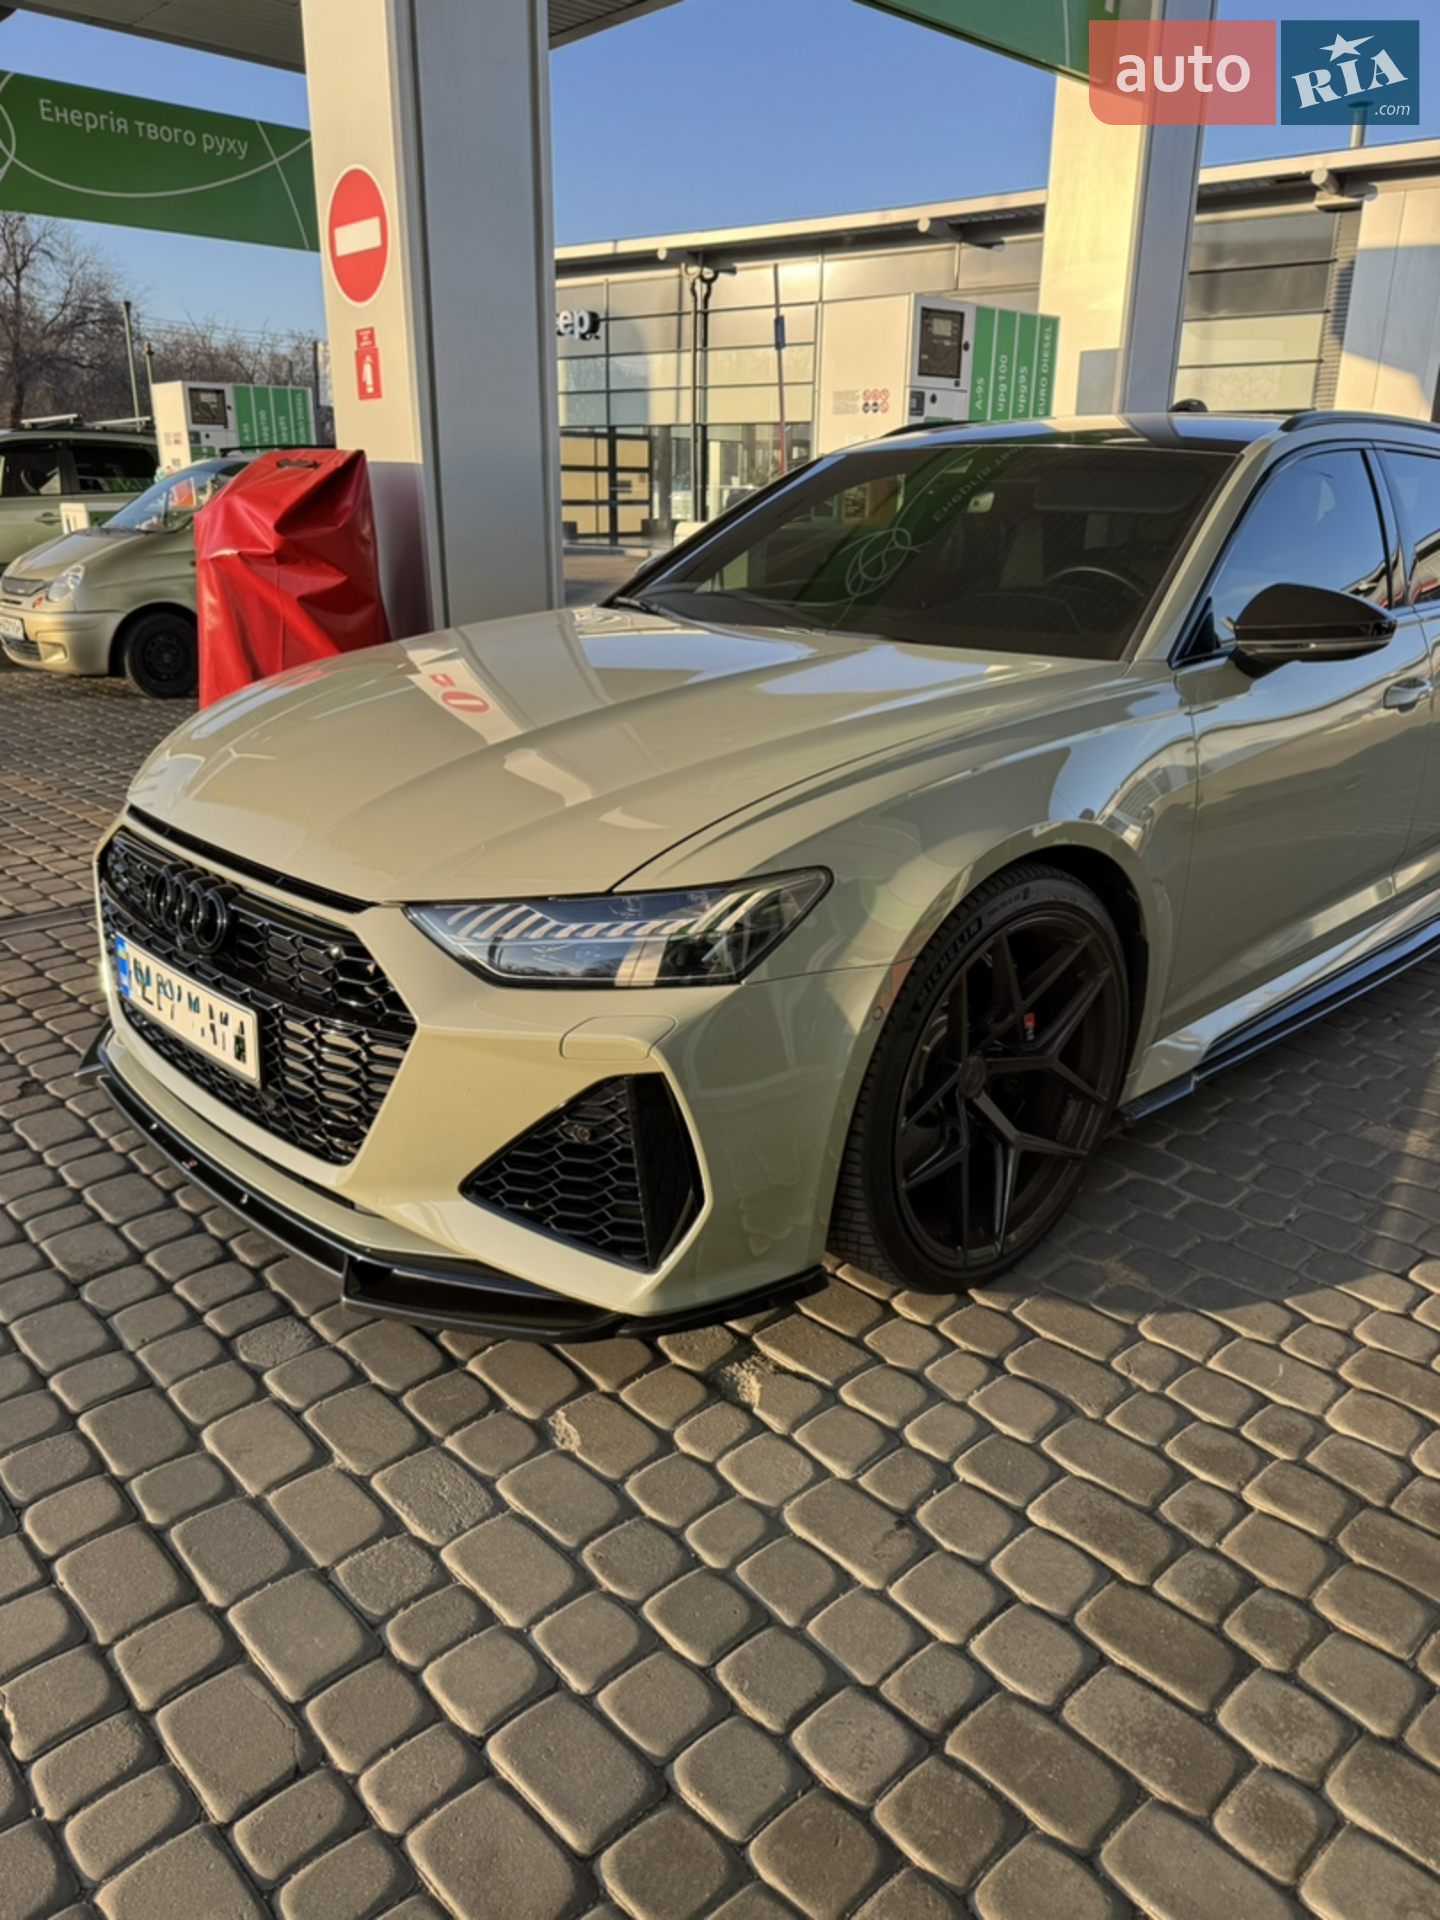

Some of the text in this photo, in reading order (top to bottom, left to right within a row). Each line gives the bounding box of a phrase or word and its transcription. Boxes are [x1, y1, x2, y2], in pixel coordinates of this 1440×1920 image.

[39, 98, 249, 161] Енергія твого руху
[997, 354, 1008, 412] upg100
[1018, 366, 1028, 413] upg95
[1038, 323, 1052, 415] EURO DIESEL
[917, 917, 981, 1004] MICHELIN
